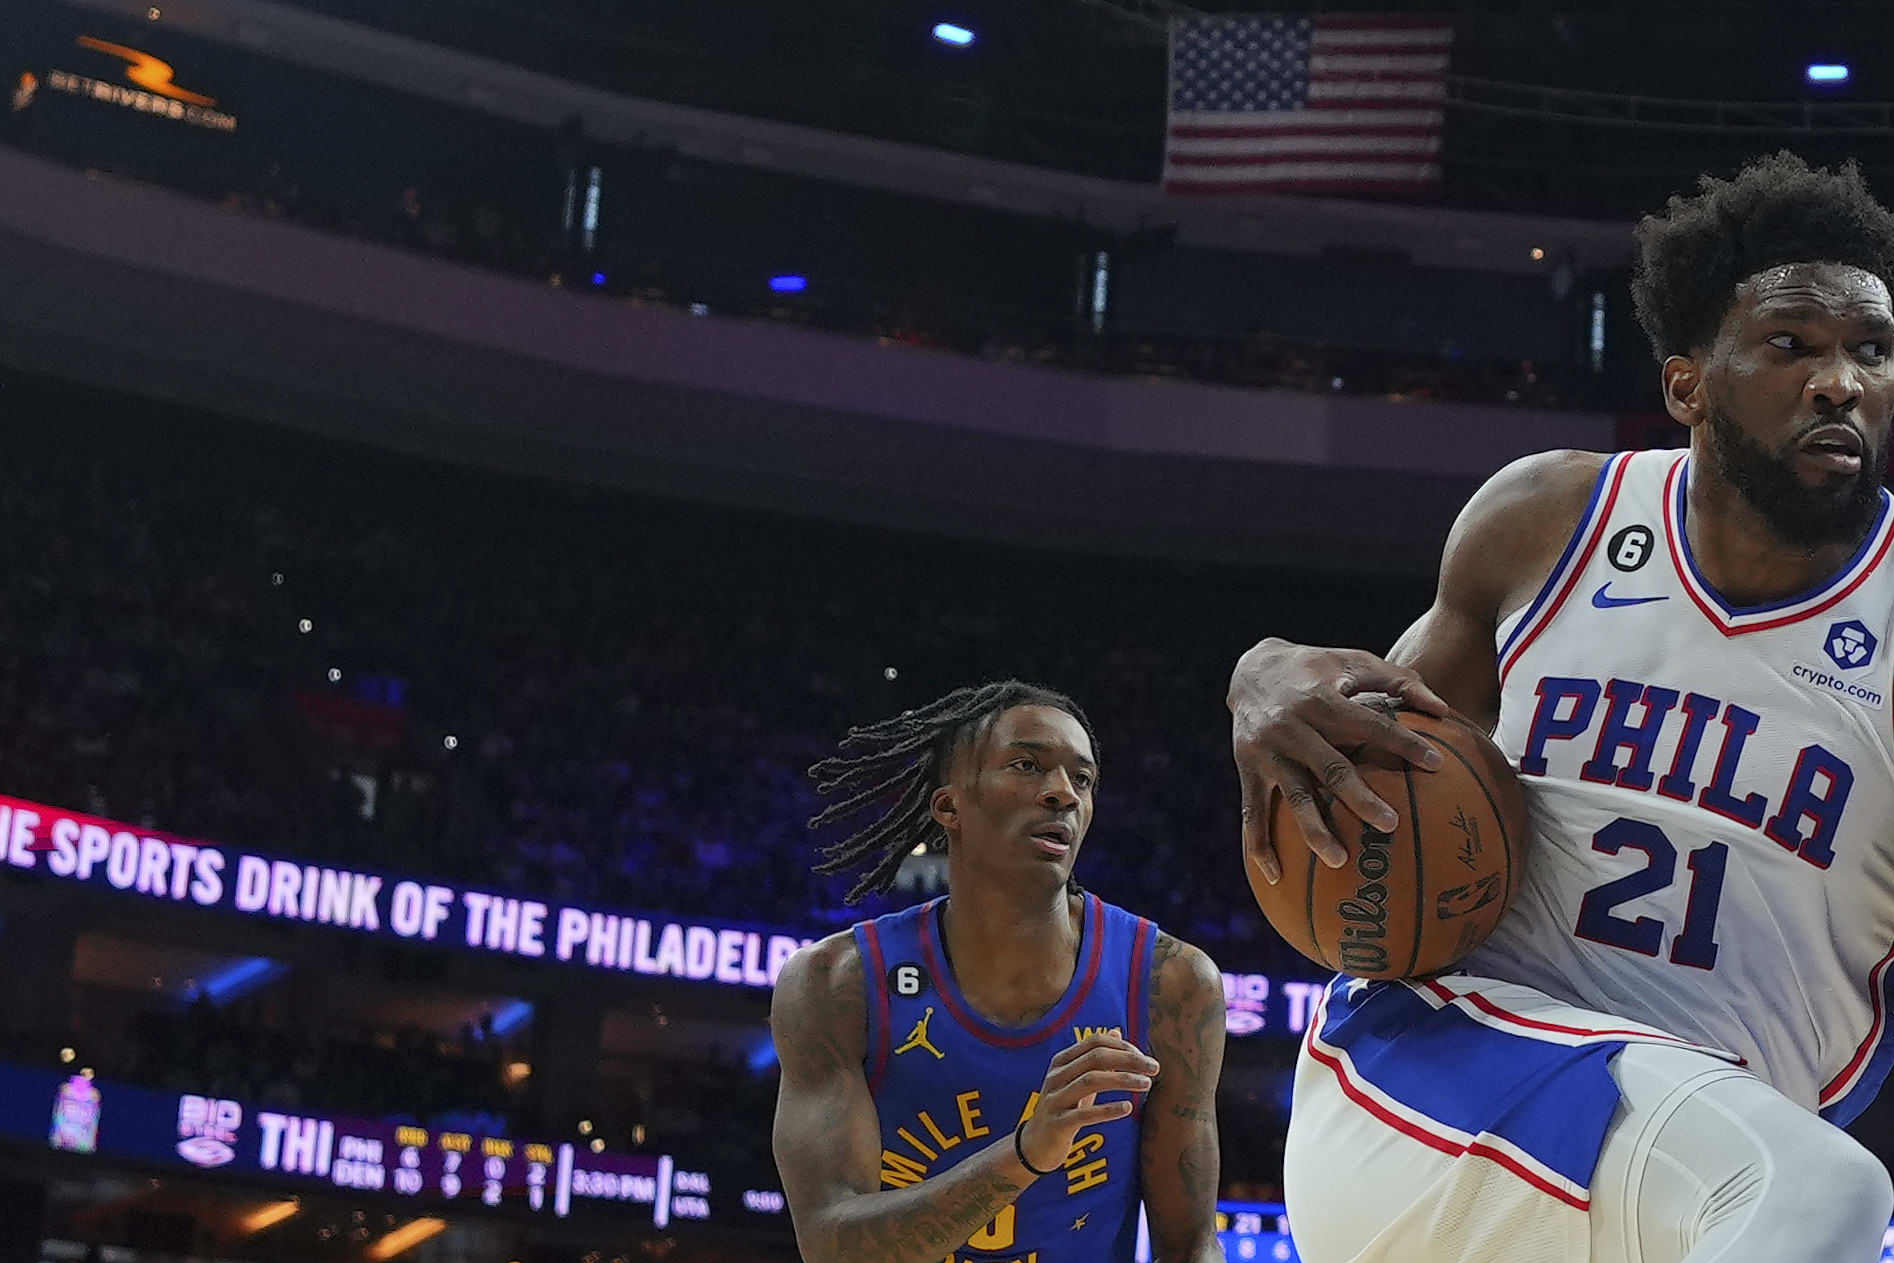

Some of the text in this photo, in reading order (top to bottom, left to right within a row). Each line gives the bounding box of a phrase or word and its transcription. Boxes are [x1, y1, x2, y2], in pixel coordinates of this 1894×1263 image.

[1616, 533, 1648, 567] 6
[1793, 662, 1882, 706] crypto.com
[1520, 677, 1855, 871] PHILA
[47, 818, 224, 906] SPORTS
[236, 856, 382, 932] DRINK
[394, 881, 450, 942] OF
[464, 893, 547, 957] THE
[558, 913, 813, 987] PHILADELP
[1338, 822, 1394, 974] Wilson
[1574, 817, 1730, 971] 21
[896, 966, 921, 995] 6
[331, 1158, 386, 1190] DEN
[394, 1167, 424, 1195] 10
[880, 1090, 990, 1190] MILE
